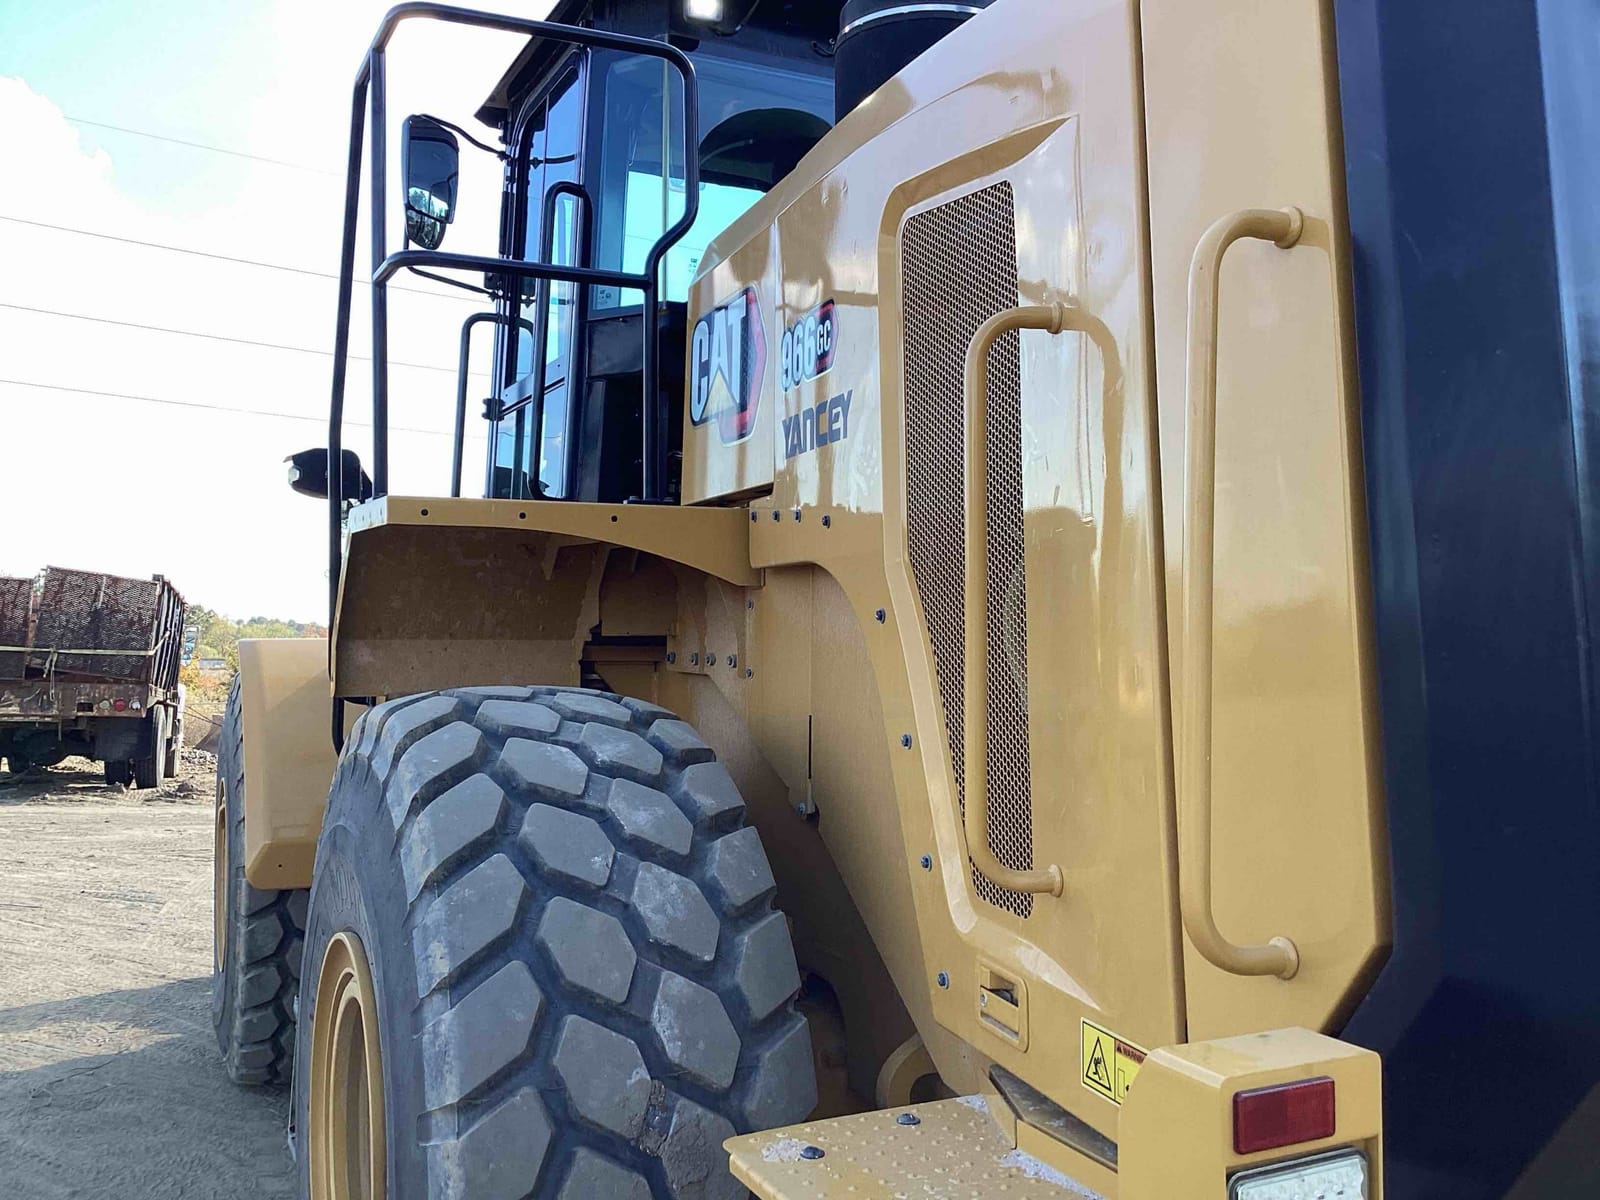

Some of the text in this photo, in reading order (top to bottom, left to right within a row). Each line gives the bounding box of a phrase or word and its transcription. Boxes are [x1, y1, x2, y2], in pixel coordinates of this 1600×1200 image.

[691, 294, 747, 424] CAT
[782, 315, 832, 391] 966 GC
[782, 389, 853, 459] YANCEY
